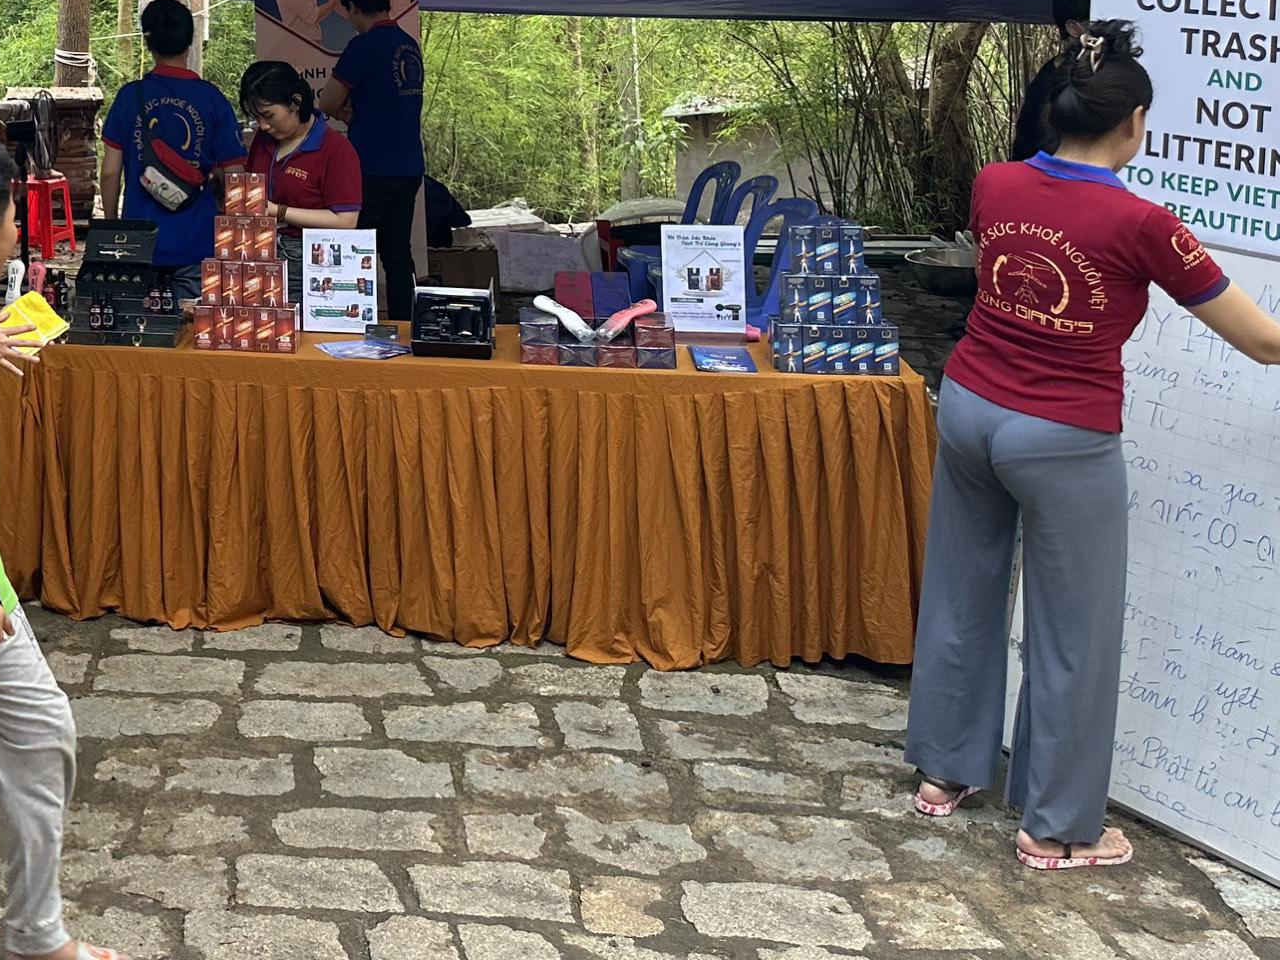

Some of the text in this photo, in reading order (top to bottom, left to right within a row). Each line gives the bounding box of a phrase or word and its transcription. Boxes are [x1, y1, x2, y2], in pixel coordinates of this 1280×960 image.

[1207, 68, 1263, 91] AND
[1196, 97, 1272, 133] NOT
[1124, 165, 1154, 186] TO
[1161, 171, 1219, 197] KEEP
[1087, 286, 1109, 312] VIỆT
[1015, 303, 1094, 334] GIANG'S
